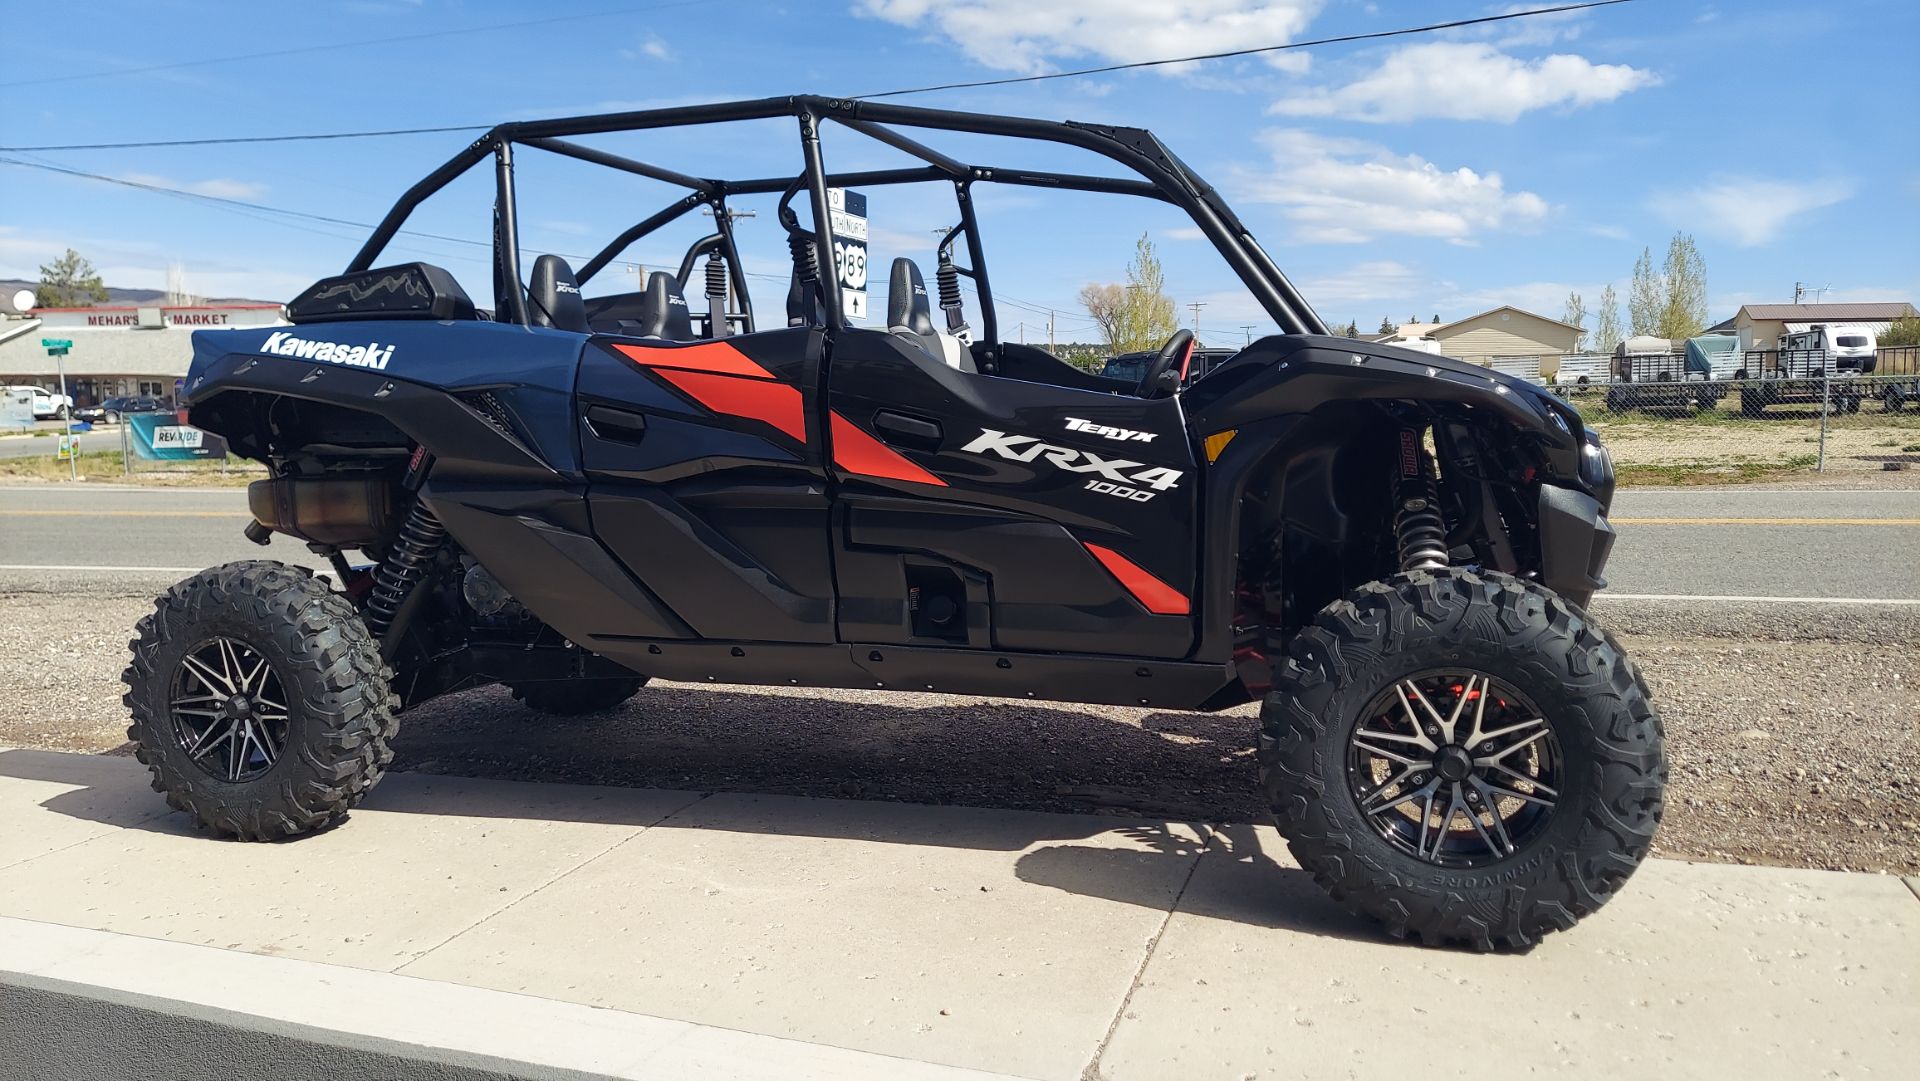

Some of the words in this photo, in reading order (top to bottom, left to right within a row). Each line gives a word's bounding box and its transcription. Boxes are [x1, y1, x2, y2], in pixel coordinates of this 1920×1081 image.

[846, 219, 866, 235] NORTH
[847, 254, 864, 278] 89
[88, 315, 139, 326] MEHAR'S
[173, 314, 228, 325] MARKET
[260, 331, 396, 370] Kawasaki
[960, 427, 1184, 491] KRX4
[1401, 431, 1419, 476] SHOWA
[1083, 479, 1157, 503] 1000
